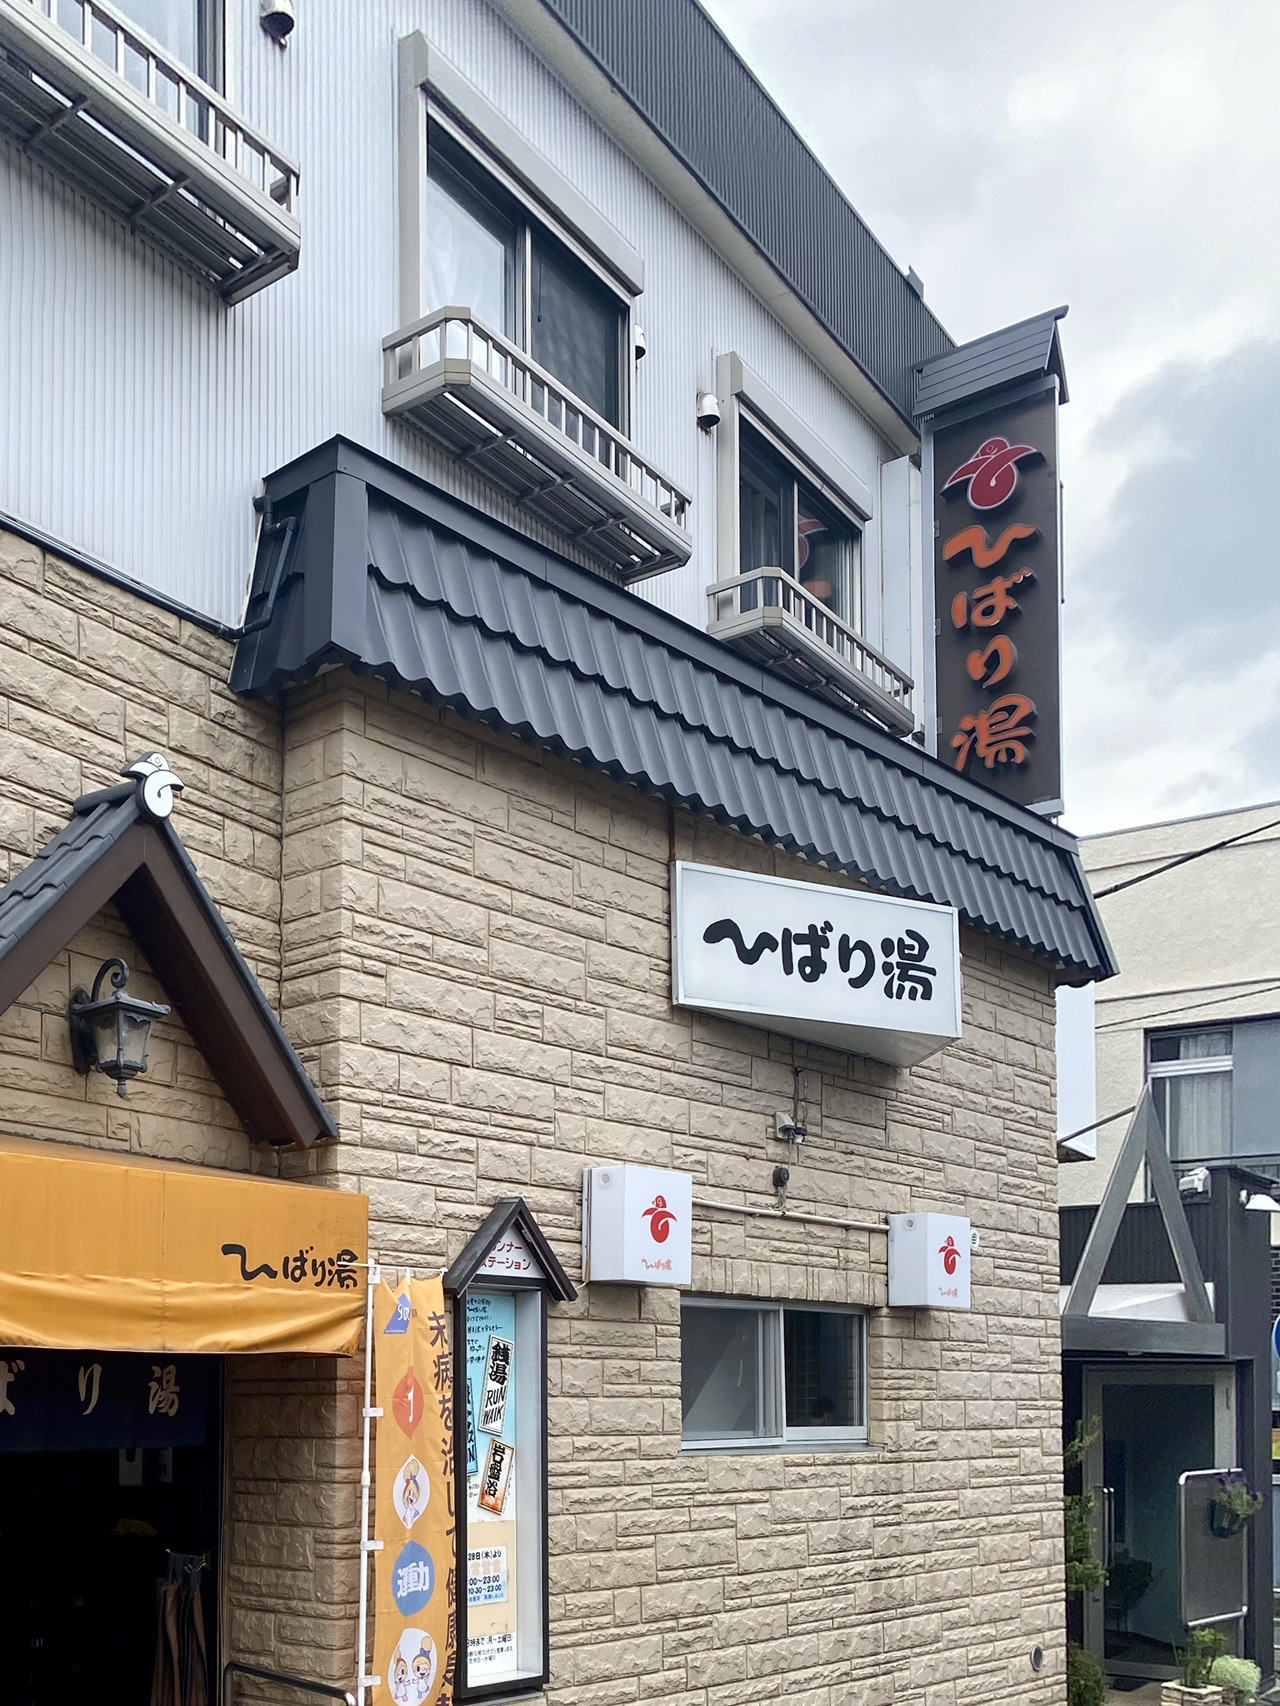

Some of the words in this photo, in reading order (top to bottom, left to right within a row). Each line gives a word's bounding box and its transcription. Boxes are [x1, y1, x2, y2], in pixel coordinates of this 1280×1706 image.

[942, 523, 1040, 772] ひばり湯
[702, 918, 937, 1001] ひばり湯
[220, 1243, 359, 1290] ひばり湯
[485, 1385, 507, 1408] RUN
